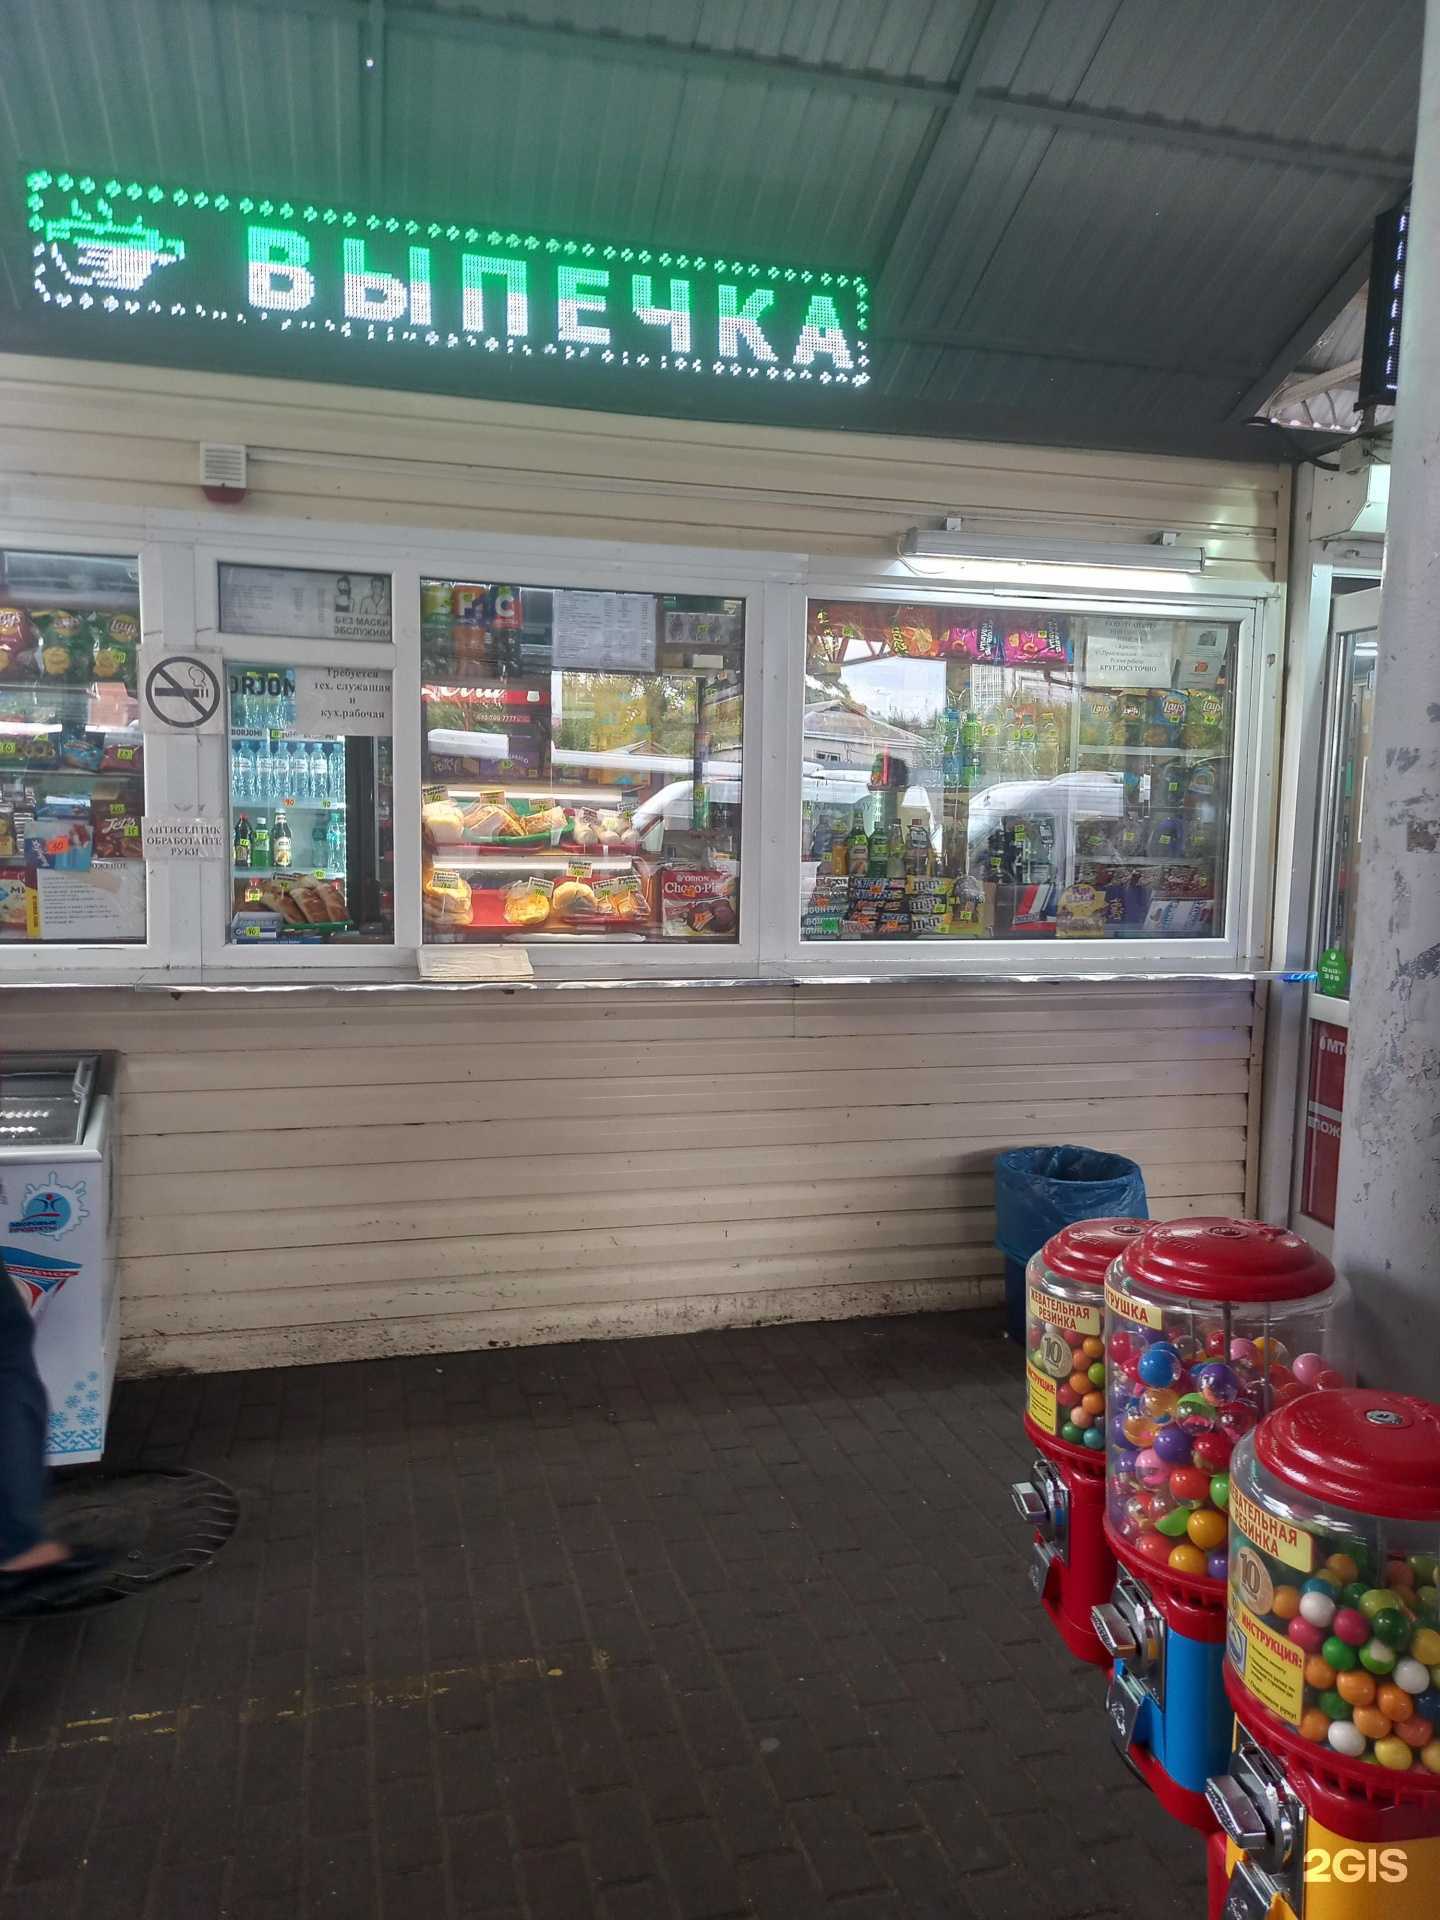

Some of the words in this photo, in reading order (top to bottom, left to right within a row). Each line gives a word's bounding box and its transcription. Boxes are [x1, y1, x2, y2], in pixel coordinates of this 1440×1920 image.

[247, 225, 855, 370] ВЫПЕЧКА
[326, 667, 379, 679] Требуется
[146, 835, 223, 846] ОБРАБОТАЙТЕ
[149, 825, 221, 835] АНТИСЕПТИК
[170, 847, 200, 857] РУКИ
[1038, 1307, 1077, 1330] РЕЗИНКА
[1043, 1336, 1063, 1366] 10
[1231, 1482, 1297, 1547] ЕВАТЕЛЬНАЯ
[1235, 1506, 1279, 1557] РЕЗИНКА
[1239, 1552, 1261, 1594] 10
